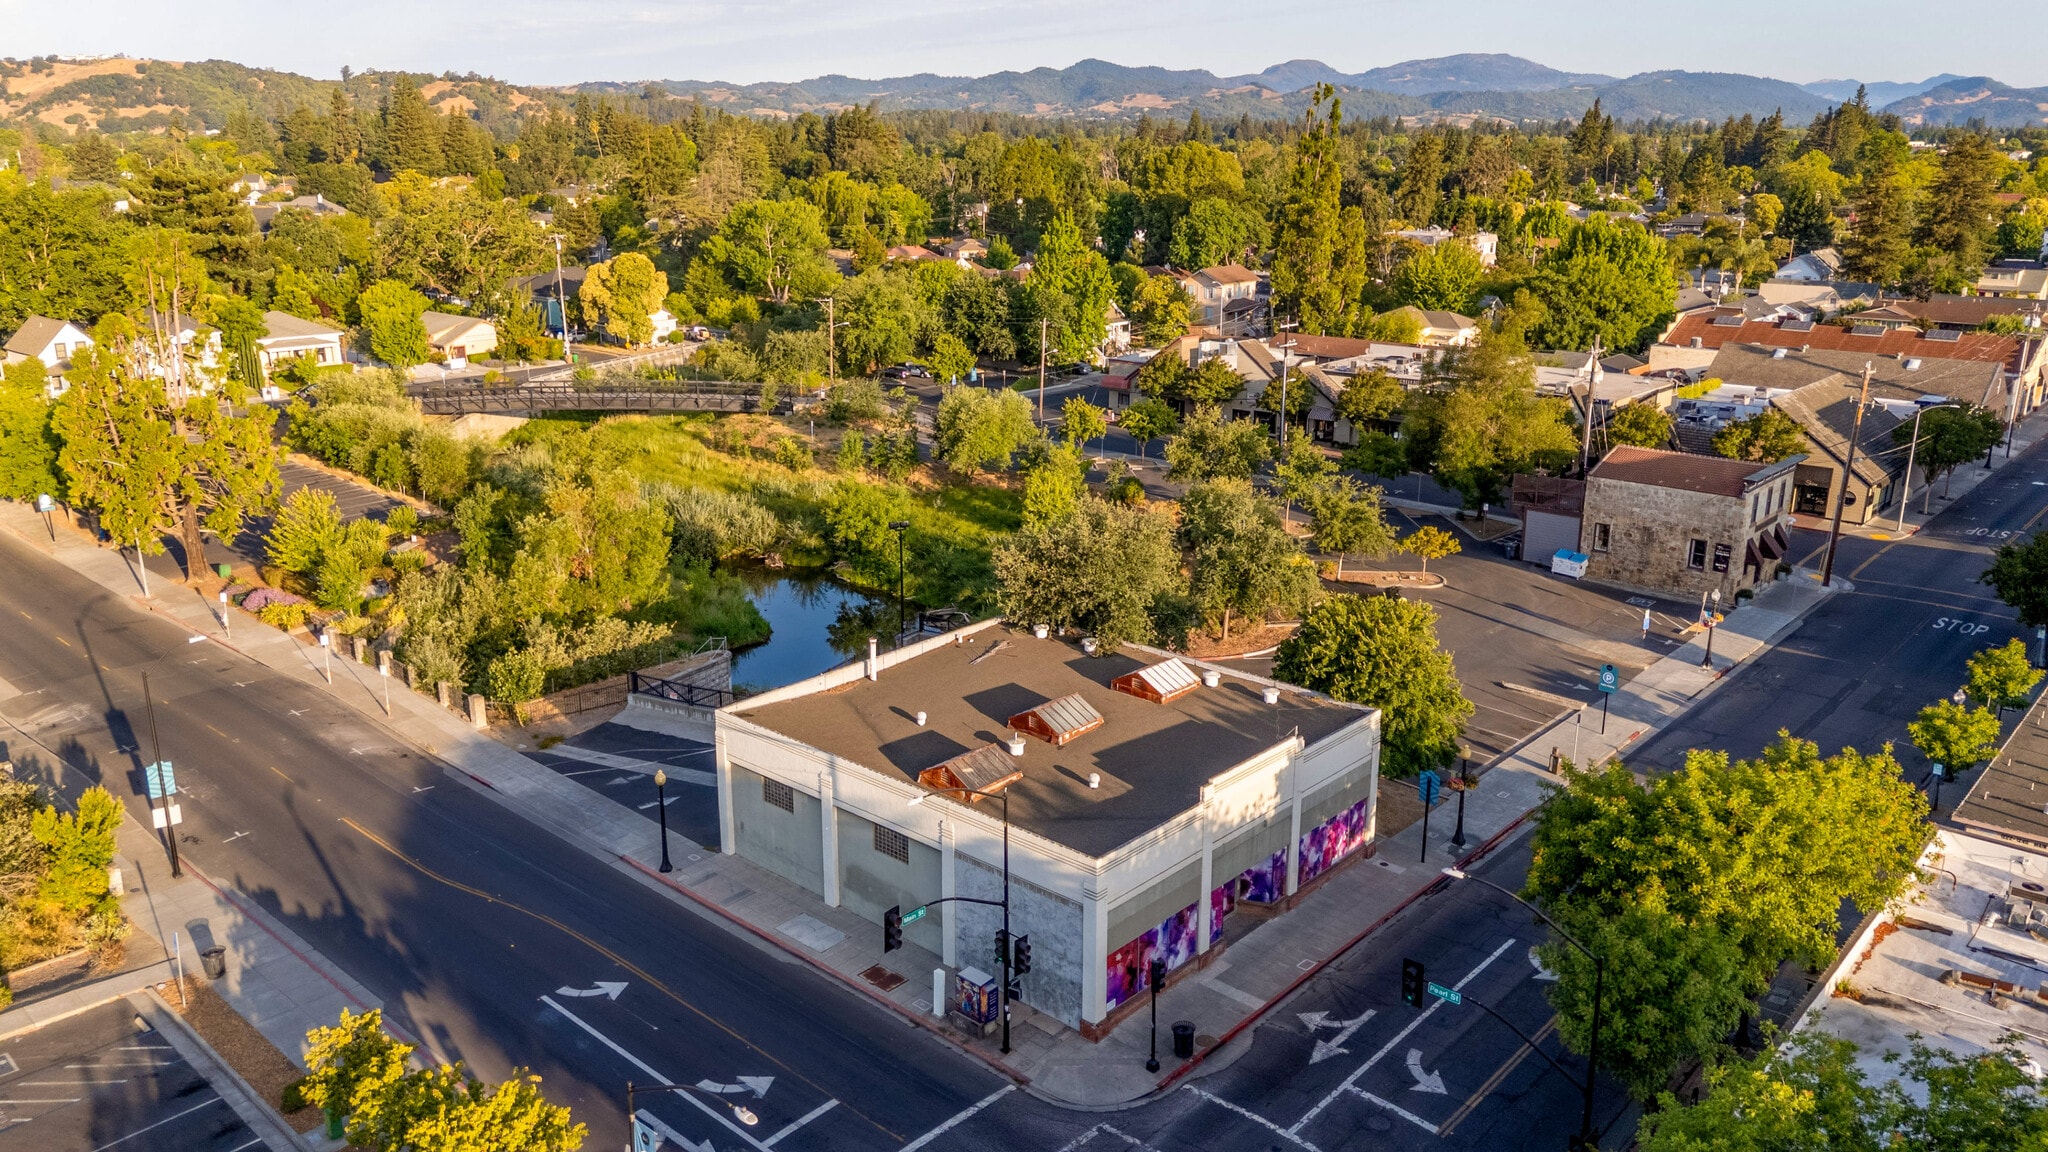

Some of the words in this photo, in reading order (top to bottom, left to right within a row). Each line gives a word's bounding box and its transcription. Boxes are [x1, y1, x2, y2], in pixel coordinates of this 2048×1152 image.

[1966, 527, 2011, 539] STOP
[1932, 617, 1990, 636] STOP
[1429, 984, 1448, 997] Pearl
[1450, 993, 1459, 1002] St
